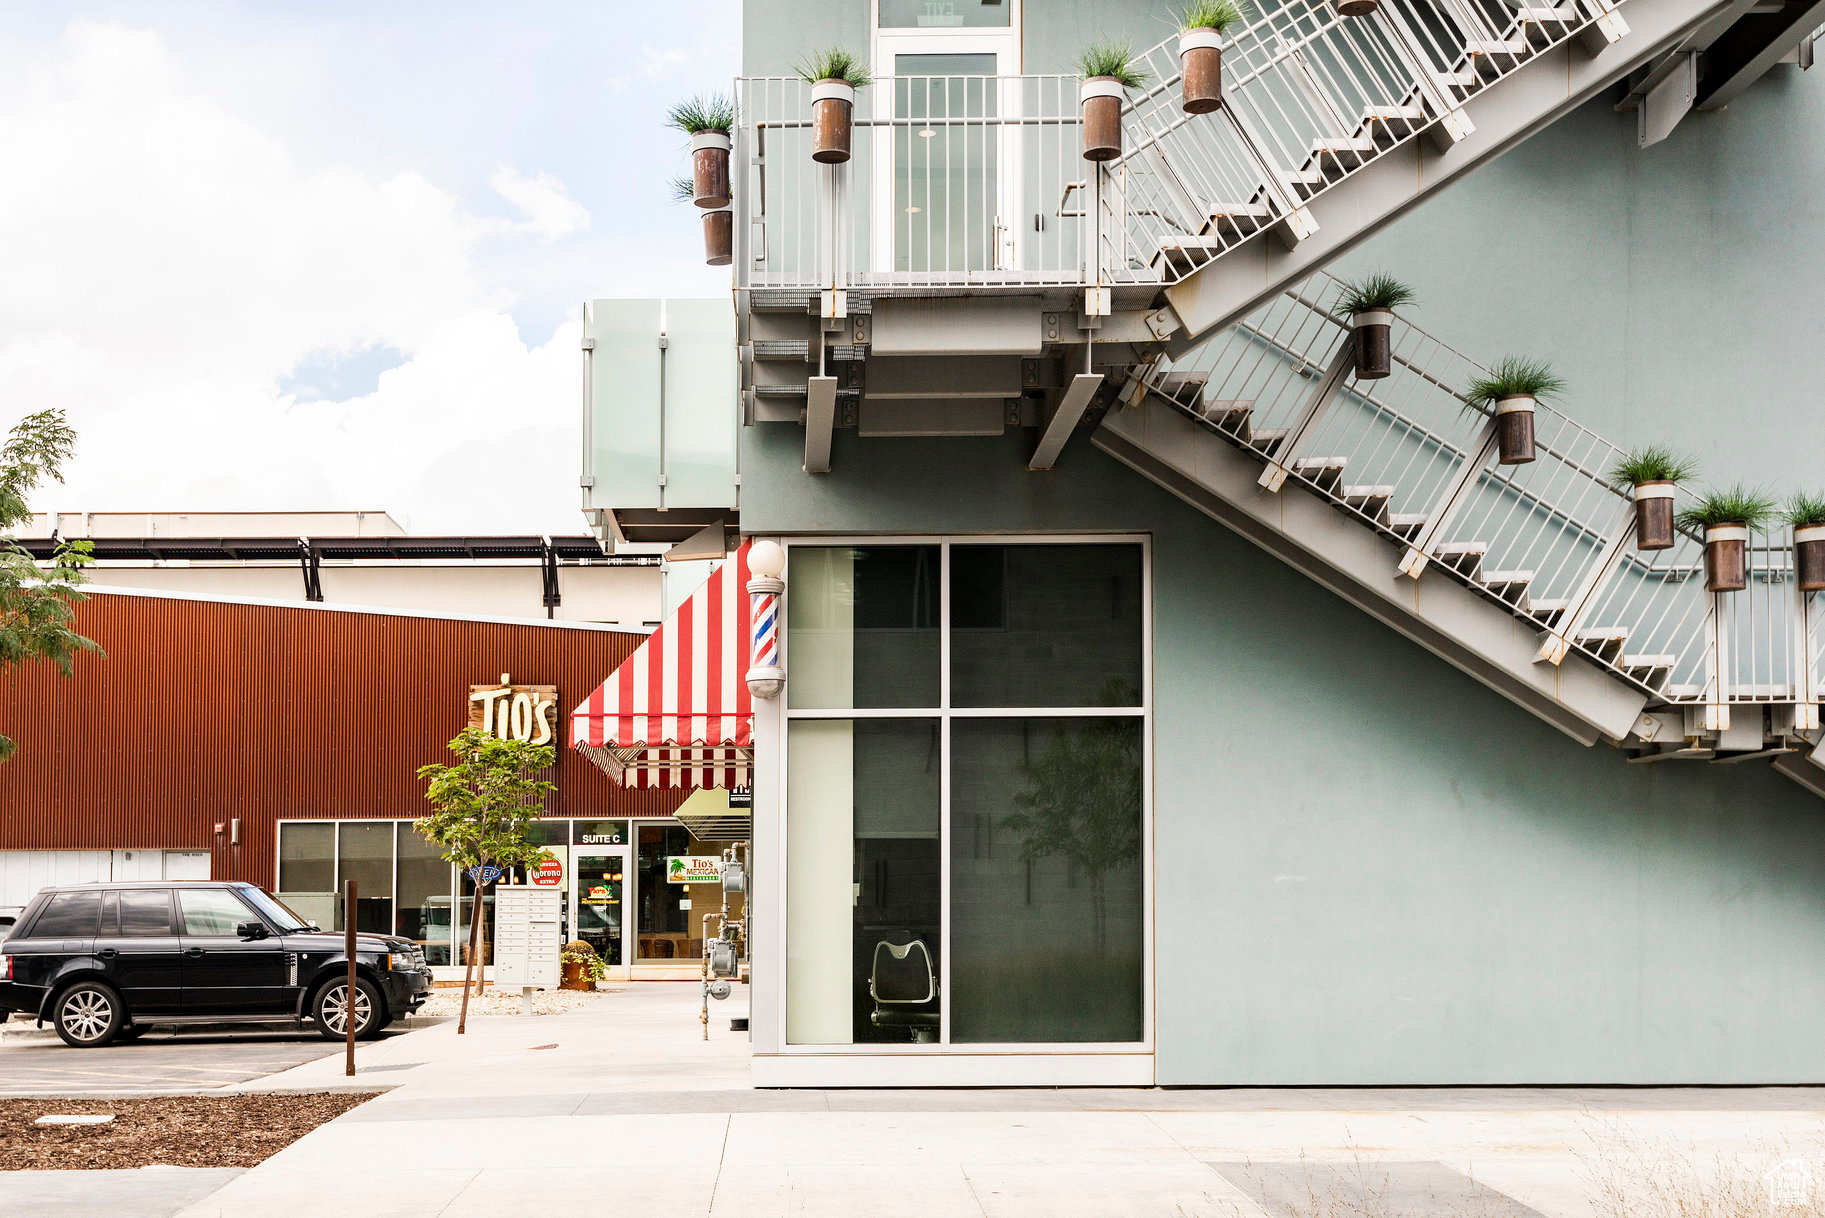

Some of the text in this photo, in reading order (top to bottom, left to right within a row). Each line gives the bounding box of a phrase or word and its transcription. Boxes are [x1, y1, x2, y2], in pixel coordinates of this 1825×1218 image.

[582, 834, 621, 844] SUITE C
[692, 859, 713, 868] Tio's
